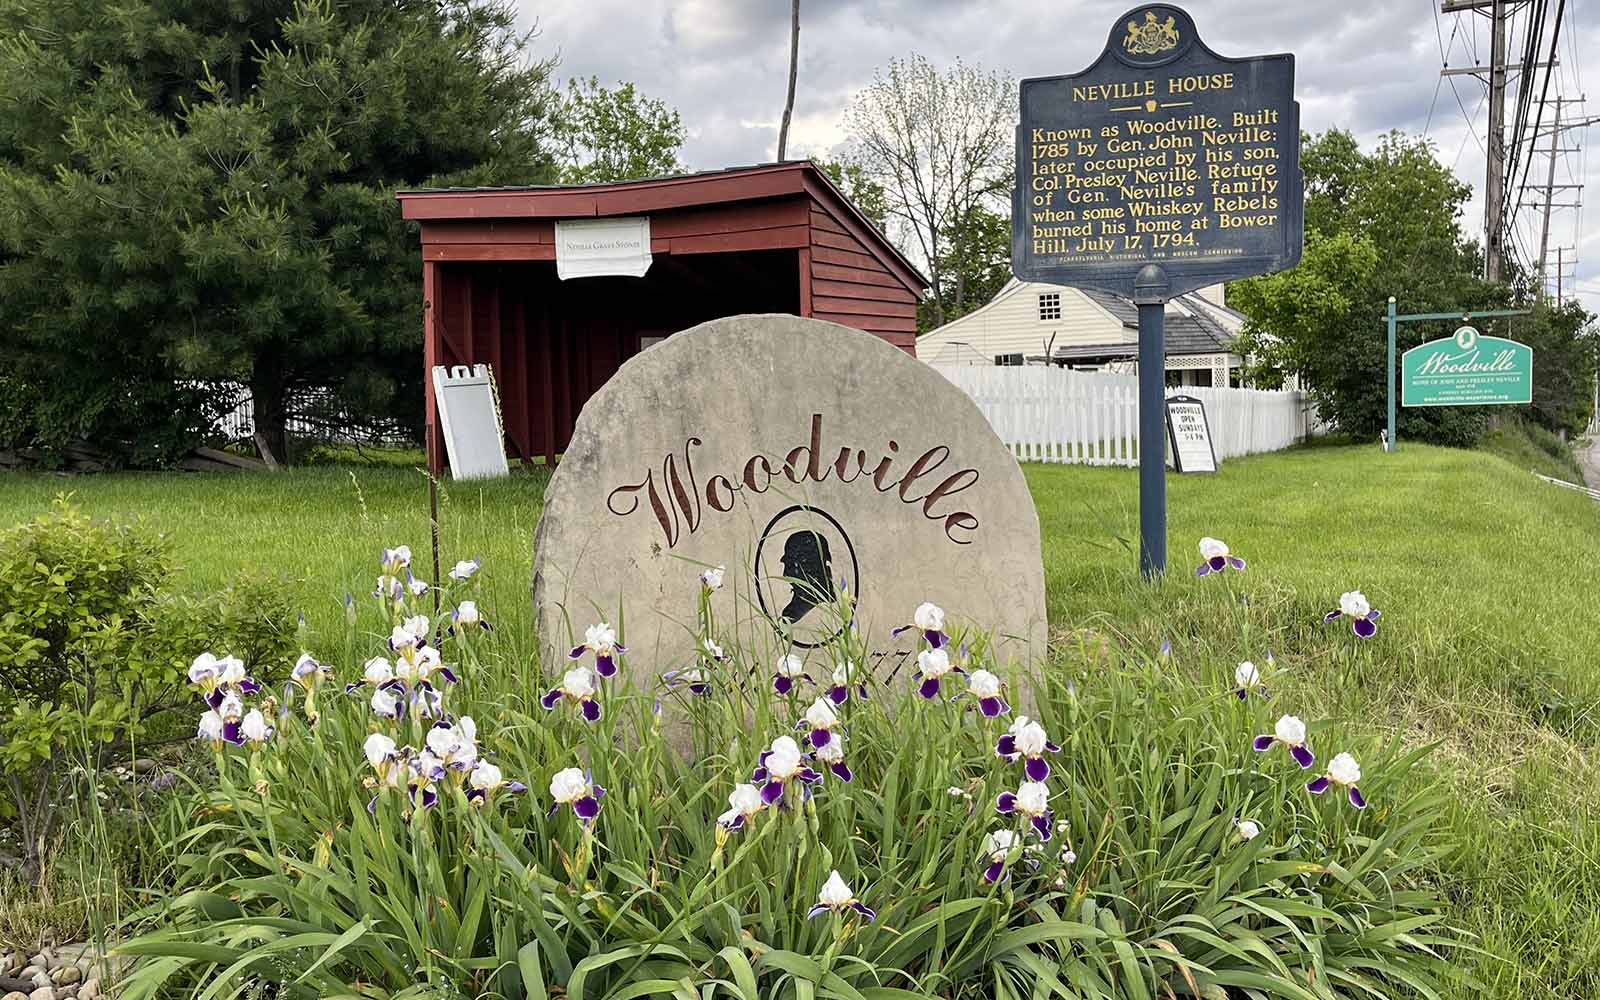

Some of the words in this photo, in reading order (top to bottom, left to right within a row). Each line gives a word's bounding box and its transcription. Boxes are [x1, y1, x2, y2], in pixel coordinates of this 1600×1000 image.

[1072, 80, 1155, 102] NEVILLE
[1168, 73, 1234, 93] HOUSE
[1032, 128, 1092, 143] Known
[1101, 126, 1119, 137] as
[1126, 117, 1222, 135] Woodville.
[1233, 109, 1278, 127] Built
[1032, 143, 1069, 159] 1785
[1077, 141, 1098, 157] by
[1107, 138, 1146, 153] Gen.
[1148, 134, 1193, 151] John
[1032, 161, 1075, 176] later
[1084, 152, 1167, 172] occupied
[1175, 150, 1197, 167] by
[1206, 147, 1233, 163] his
[1032, 176, 1063, 191] Col.
[1065, 173, 1127, 188] Presley
[1135, 167, 1201, 184] Neville.
[1208, 163, 1277, 180] Refuge
[1033, 192, 1053, 206] of
[1067, 189, 1109, 204] Gen.
[1120, 181, 1196, 201] Neville's
[1211, 177, 1279, 195] family
[1032, 209, 1075, 222] when
[1082, 206, 1125, 220] some
[1127, 200, 1204, 217] Whiskey
[1213, 195, 1278, 212] Rebels
[1032, 222, 1093, 239] burned
[1101, 219, 1126, 235] his
[1135, 219, 1183, 233] home
[1190, 216, 1209, 230] at
[1219, 213, 1278, 229] Bower
[1075, 236, 1115, 253] July
[1152, 231, 1200, 249] 1794.
[1415, 345, 1517, 375] Woodville
[1170, 406, 1201, 415] WOODVILLE
[1181, 415, 1196, 423] OPEN
[1178, 424, 1204, 433] SUNDAYS
[607, 413, 980, 549] Woodville
